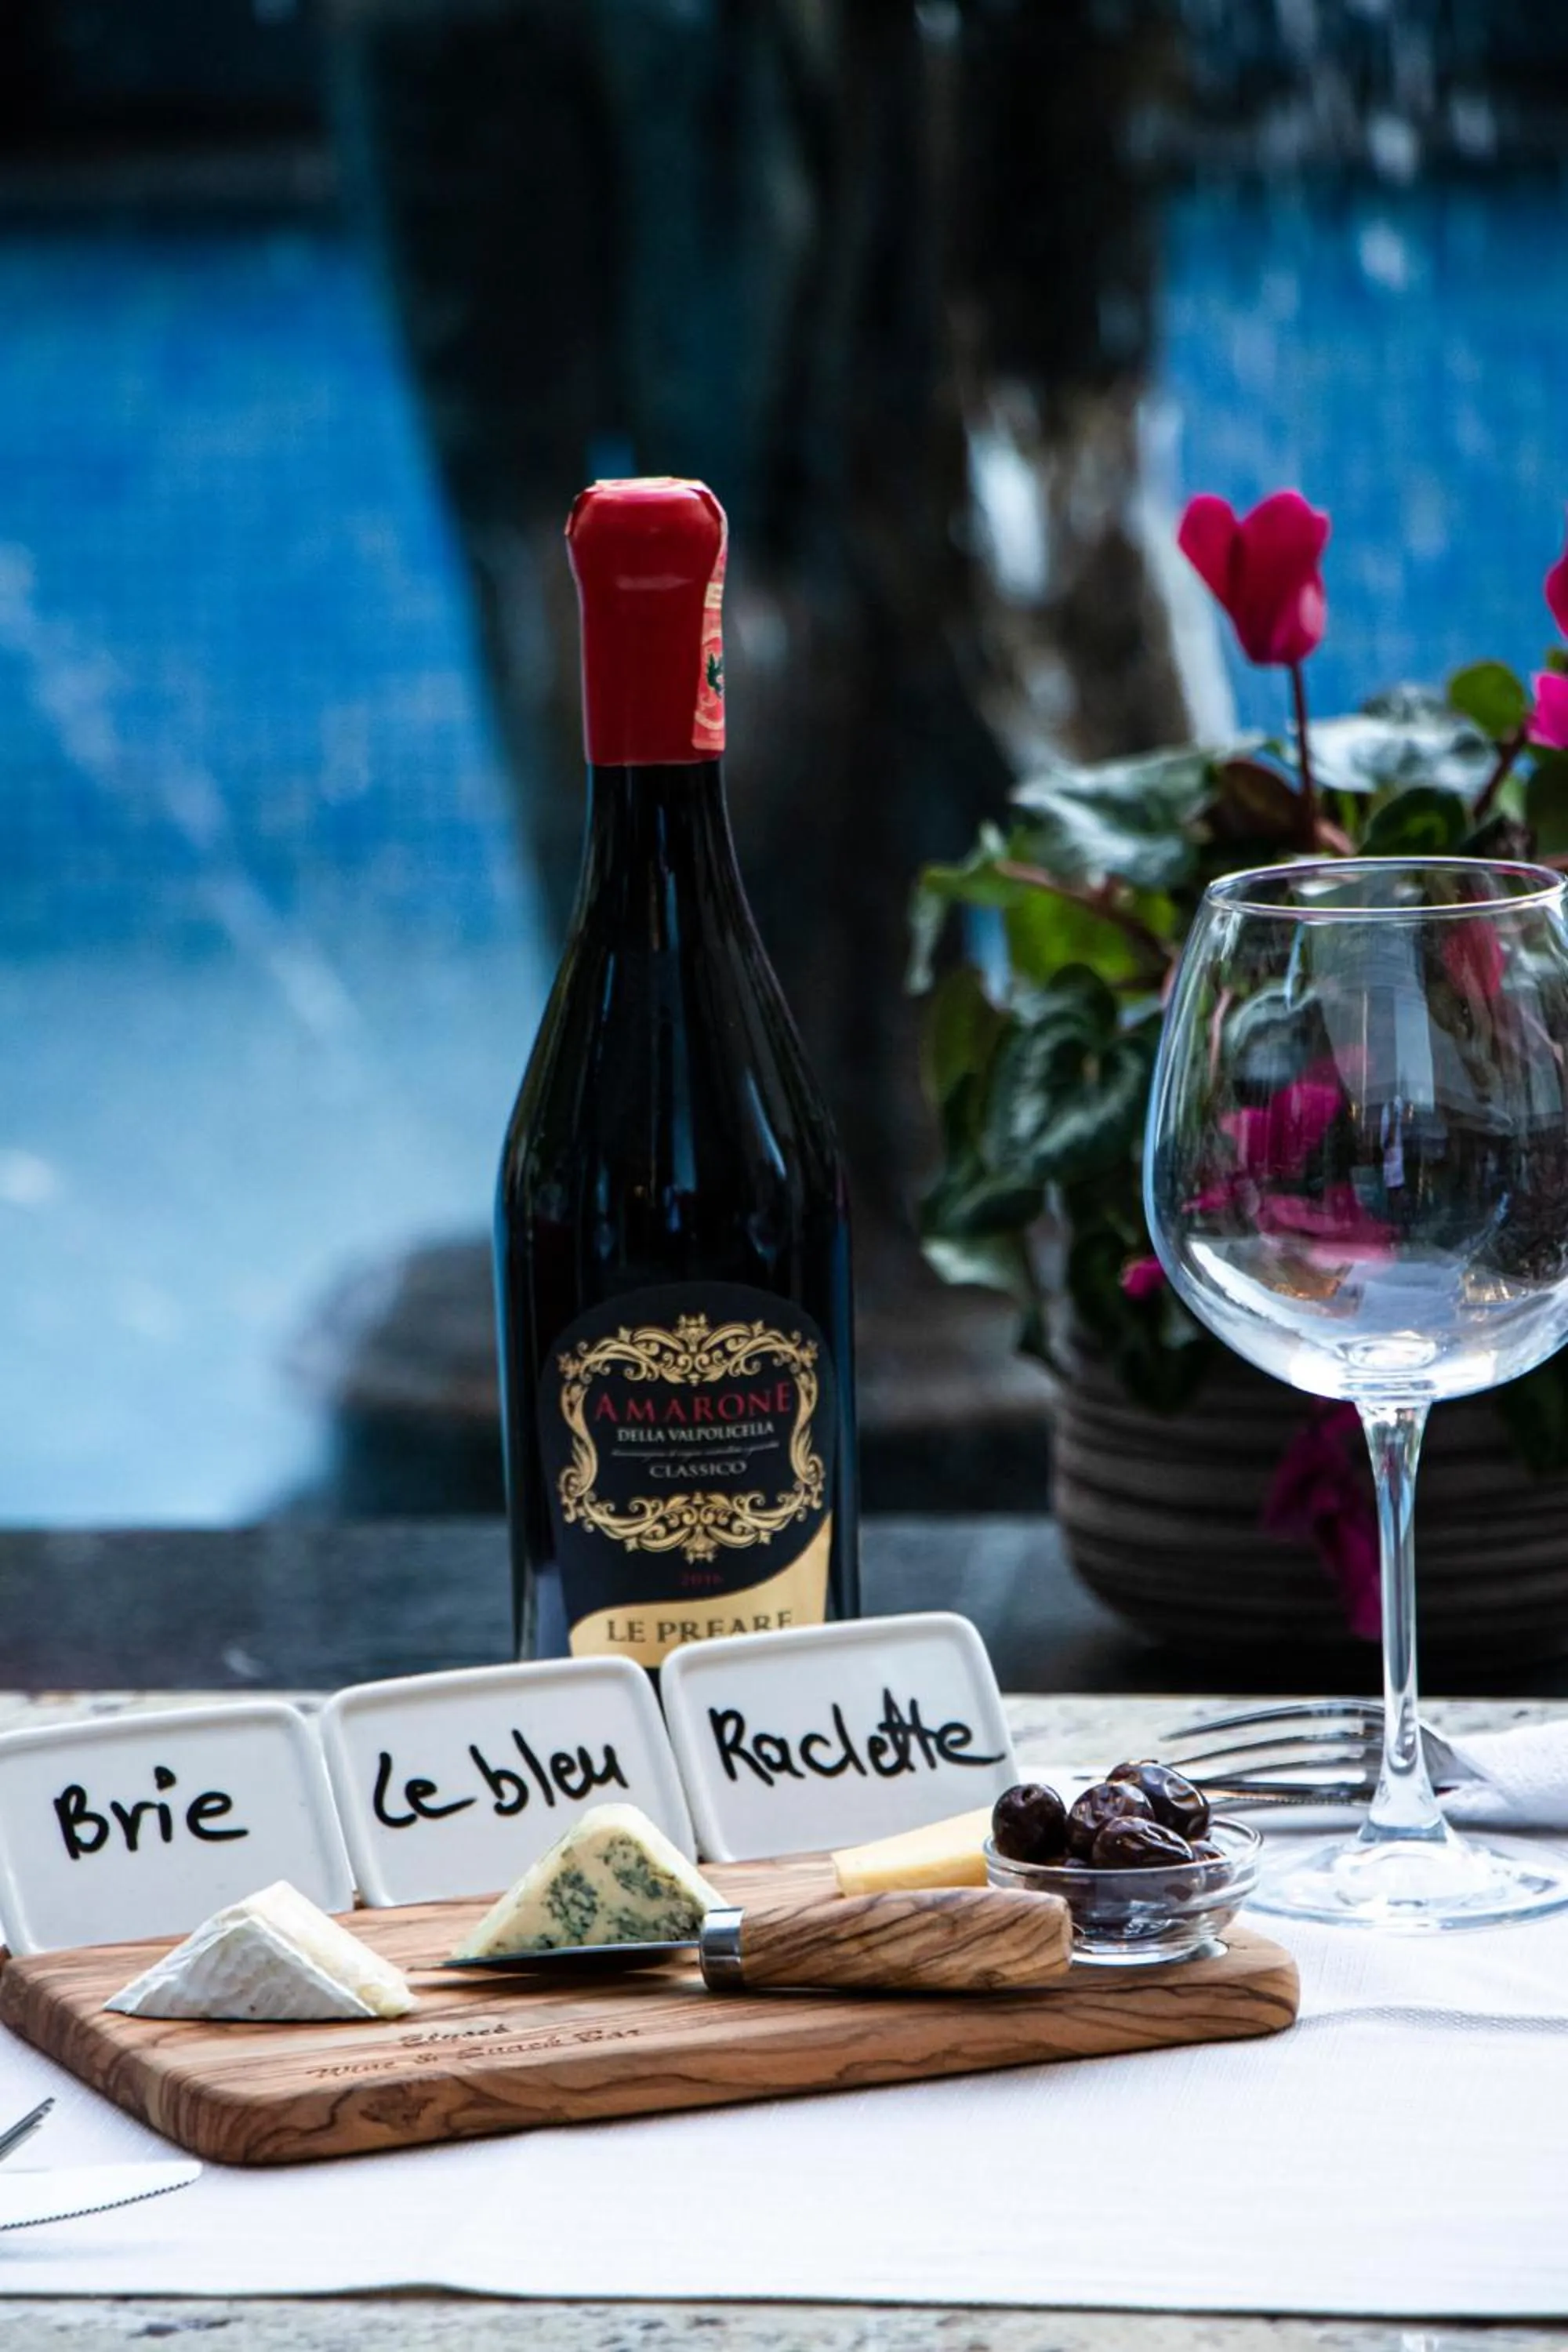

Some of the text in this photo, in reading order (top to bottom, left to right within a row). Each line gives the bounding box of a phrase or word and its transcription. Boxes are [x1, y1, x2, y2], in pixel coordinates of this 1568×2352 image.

[594, 1381, 791, 1423] AMARONE
[617, 1421, 775, 1443] DELLA VALPOLICELLA
[649, 1461, 747, 1479] CLASSICO
[607, 1620, 646, 1643] LE
[708, 1686, 1006, 1786] Raclette
[469, 1729, 630, 1817] bleu
[53, 1766, 249, 1860] Brie
[306, 2060, 398, 2079] Wine
[457, 2036, 562, 2060] Snack
[573, 2029, 641, 2045] Bar
